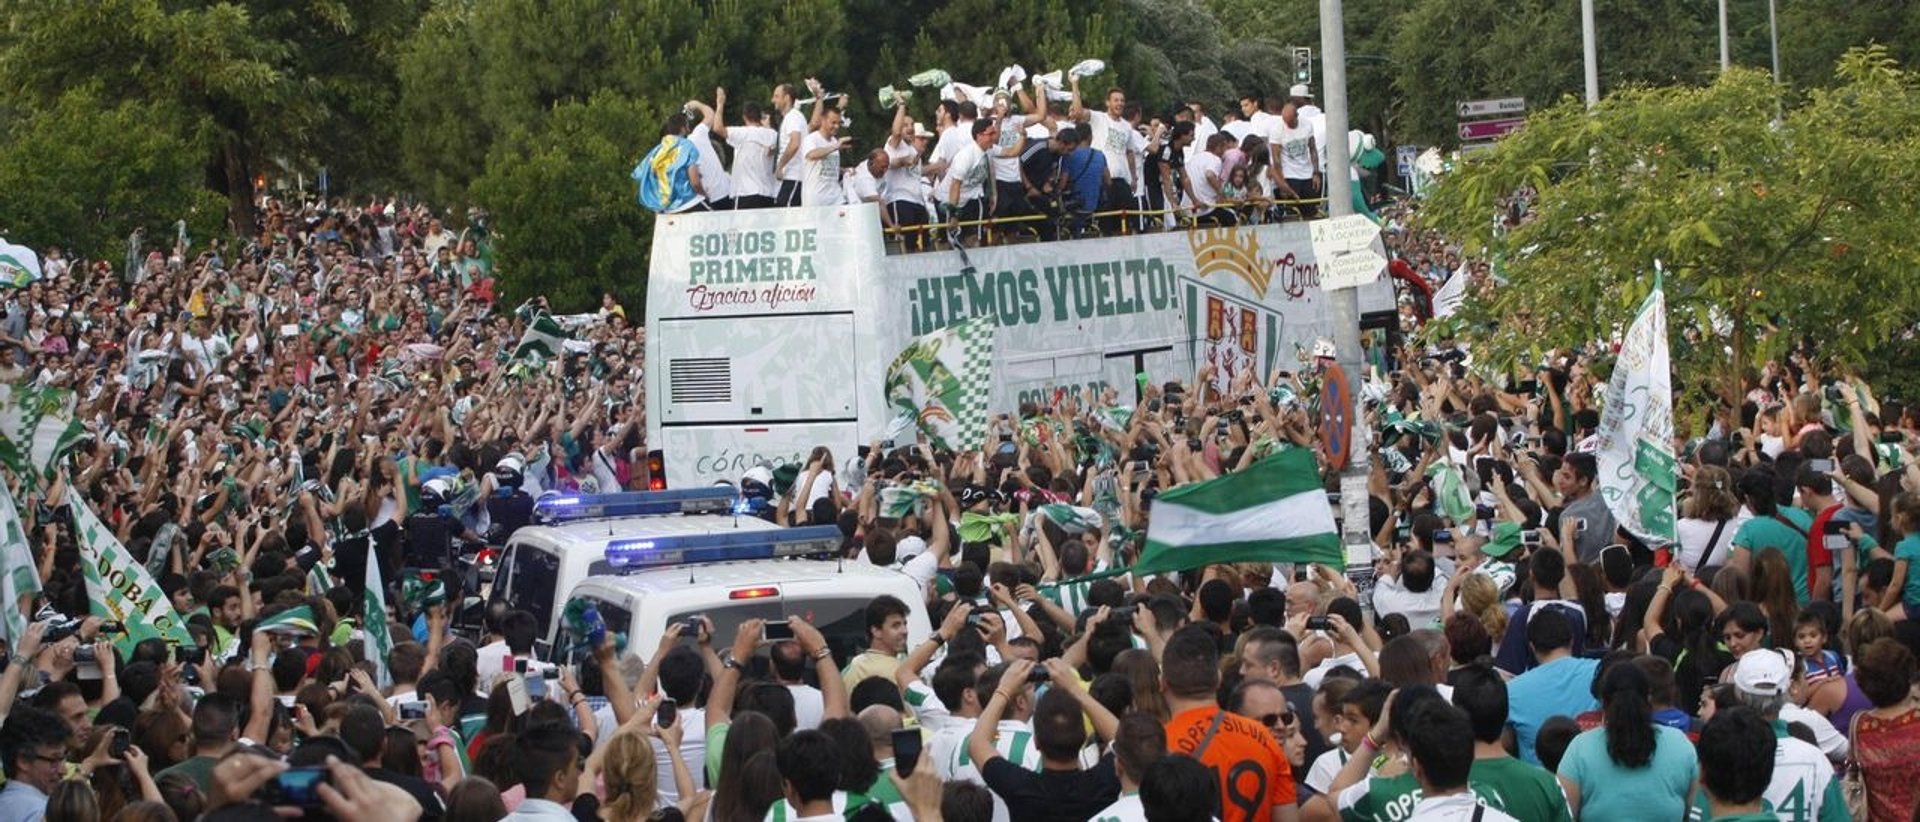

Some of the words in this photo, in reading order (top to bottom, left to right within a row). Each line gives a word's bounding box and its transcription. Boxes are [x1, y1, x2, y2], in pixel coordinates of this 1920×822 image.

[785, 229, 817, 252] DE
[1331, 228, 1374, 241] LOCKERS
[686, 284, 757, 311] Gracias
[761, 282, 816, 309] afición
[1044, 257, 1179, 322] VUELTO!
